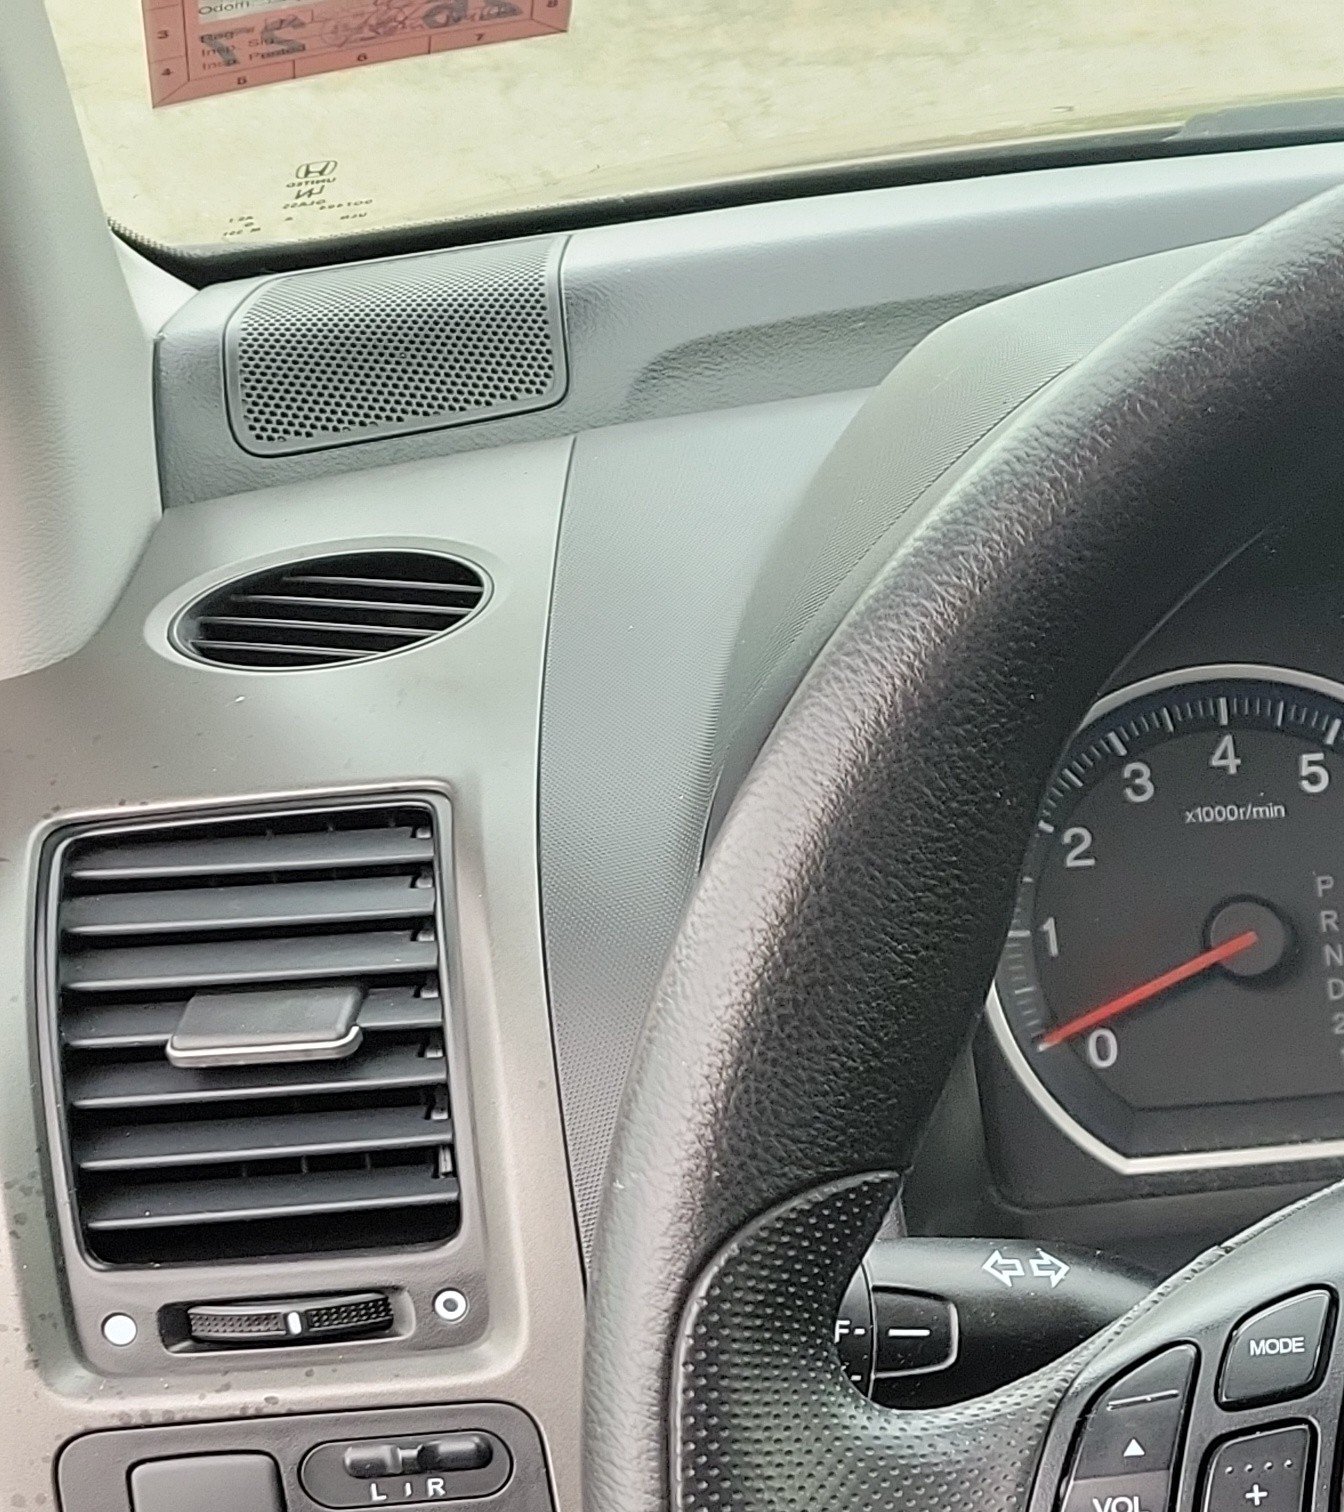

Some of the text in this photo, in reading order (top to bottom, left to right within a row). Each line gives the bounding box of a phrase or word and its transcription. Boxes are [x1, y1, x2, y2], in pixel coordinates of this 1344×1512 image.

[1211, 733, 1242, 776] 4
[1122, 761, 1156, 804] 3
[1298, 752, 1330, 794] 5
[1184, 800, 1286, 825] x1000r/min
[1061, 826, 1097, 869] 2
[1315, 875, 1335, 898] P
[1319, 910, 1339, 933] R
[1040, 916, 1060, 958] 1
[1323, 945, 1344, 968] N
[1086, 1026, 1119, 1069] 0
[1249, 1335, 1306, 1357] MODE
[370, 1482, 387, 1502] L
[427, 1477, 448, 1498] R
